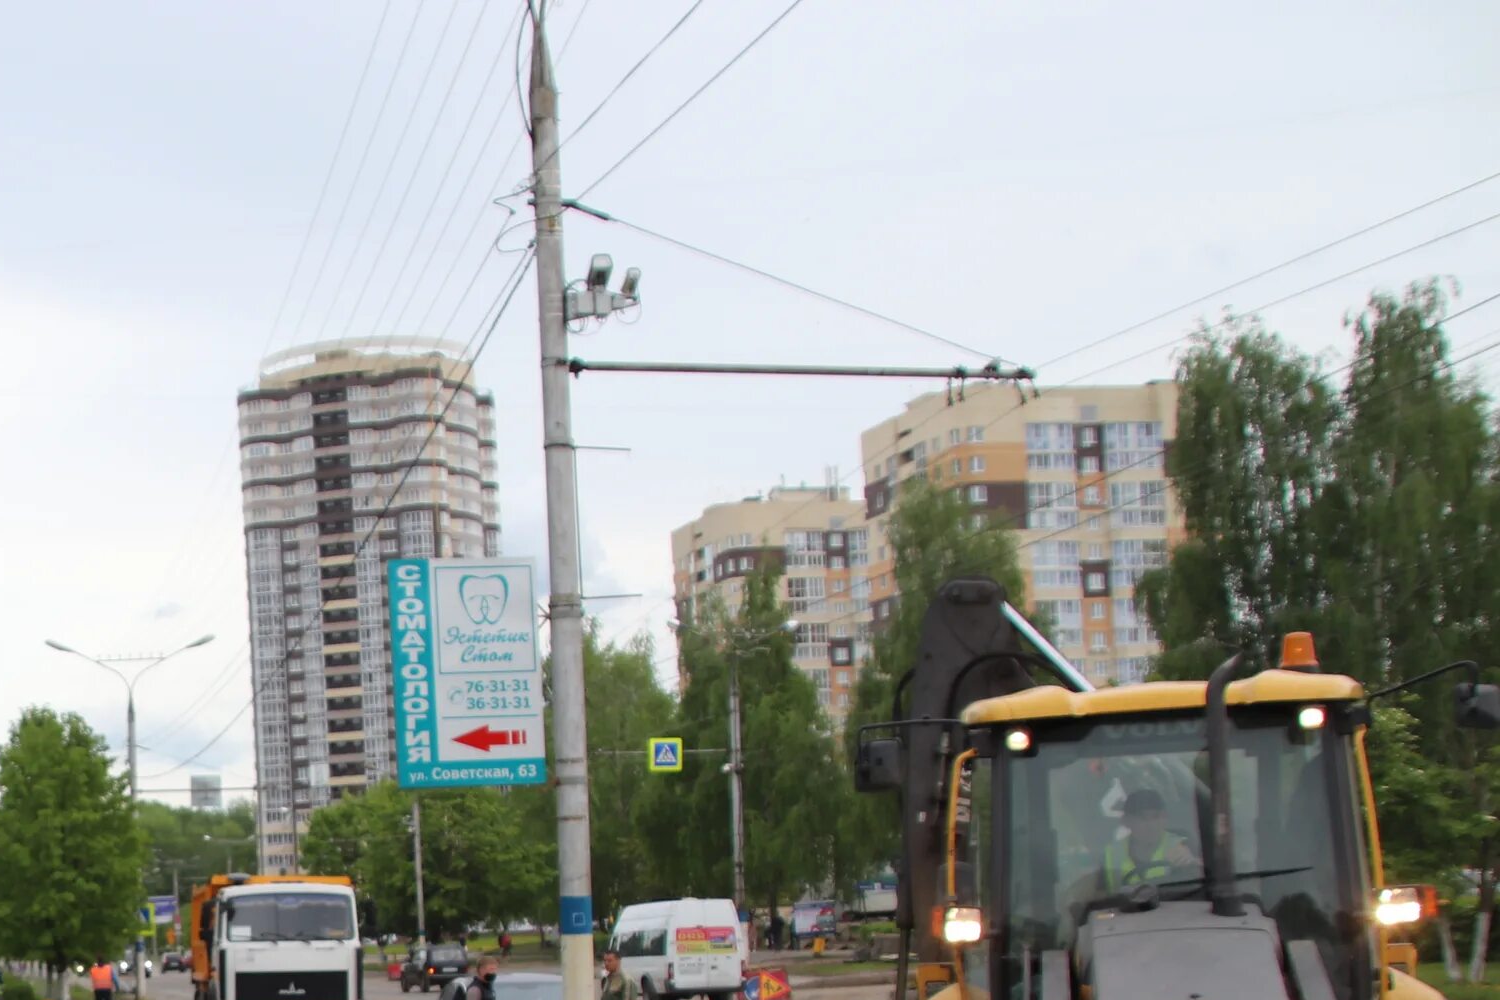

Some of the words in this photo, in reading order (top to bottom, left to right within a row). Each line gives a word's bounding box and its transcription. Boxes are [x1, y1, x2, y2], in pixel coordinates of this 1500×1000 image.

[443, 625, 530, 645] Эстетик
[461, 644, 514, 663] Стом
[397, 564, 432, 763] СТОМАТОЛОГИЯ
[466, 679, 530, 693] 76-31-31
[467, 695, 532, 710] 36-31-31
[409, 771, 429, 784] ул.
[431, 766, 514, 780] Советская,
[518, 763, 538, 777] 63
